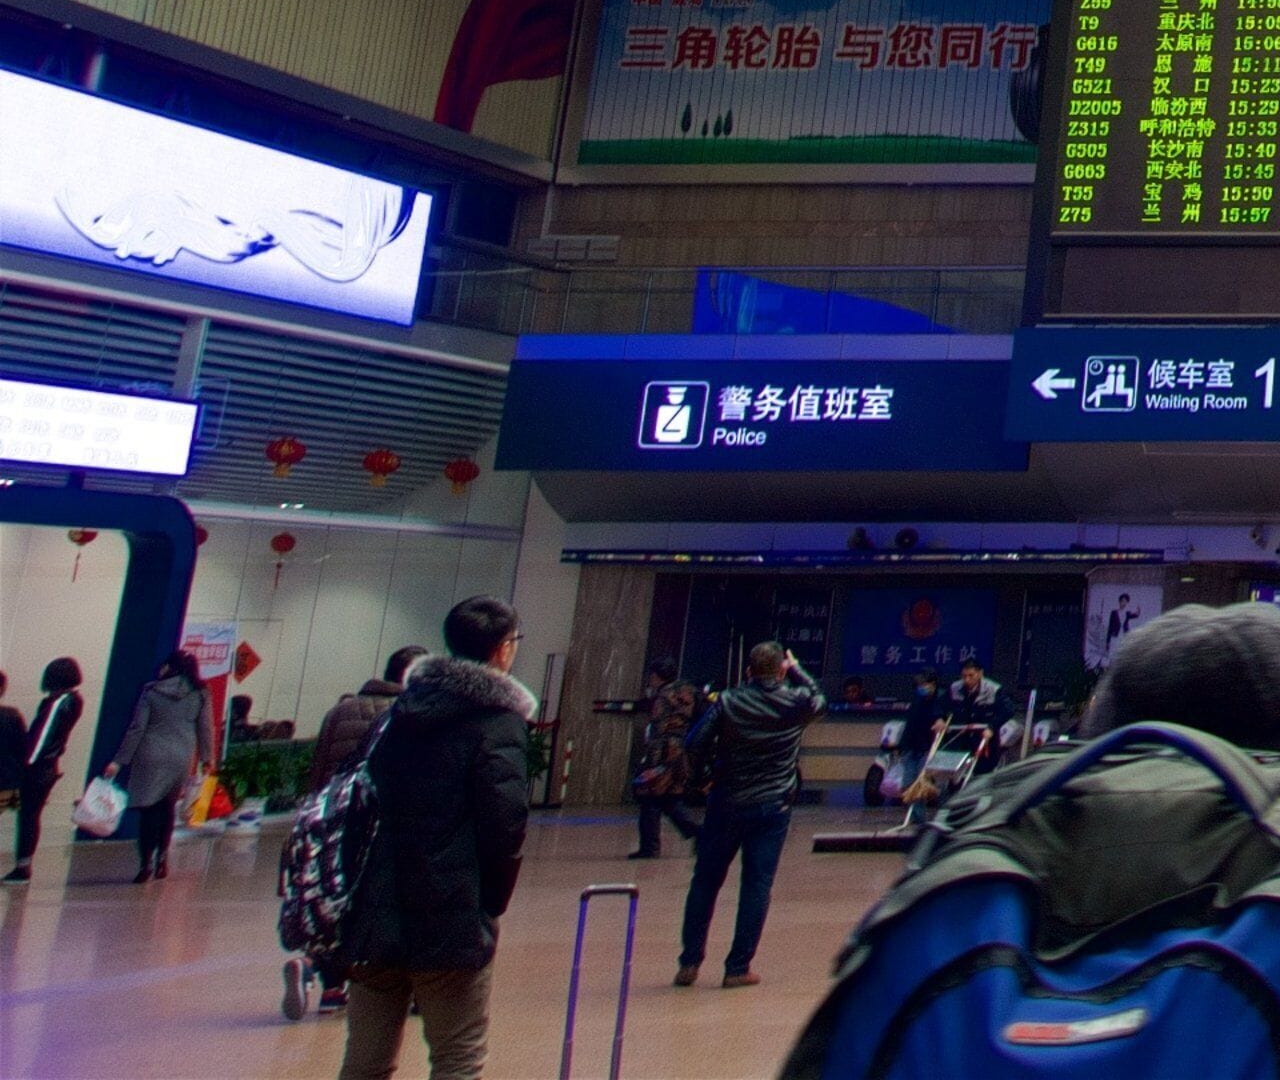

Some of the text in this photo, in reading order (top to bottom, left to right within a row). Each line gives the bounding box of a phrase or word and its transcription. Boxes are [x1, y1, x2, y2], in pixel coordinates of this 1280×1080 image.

[1079, 15, 1100, 31] T9
[1157, 11, 1215, 32] 重庆北
[621, 22, 1036, 71] 三角轮胎 与您同行
[1068, 99, 1122, 116] D2005
[1150, 96, 1208, 117] 临汾西
[1228, 99, 1280, 116] 15:29
[1067, 120, 1110, 137] Z315
[1139, 117, 1217, 139] 呼和浩特
[1227, 120, 1278, 137] 15:33
[1065, 142, 1108, 159] G505
[1147, 138, 1205, 159] 长沙南
[1225, 142, 1277, 159] 15:40
[1148, 359, 1234, 389] 候车室
[719, 385, 893, 421] 警务值班室
[1145, 394, 1247, 412] Waiting Room
[713, 428, 766, 445] Police
[860, 643, 979, 666] 警务工作站
